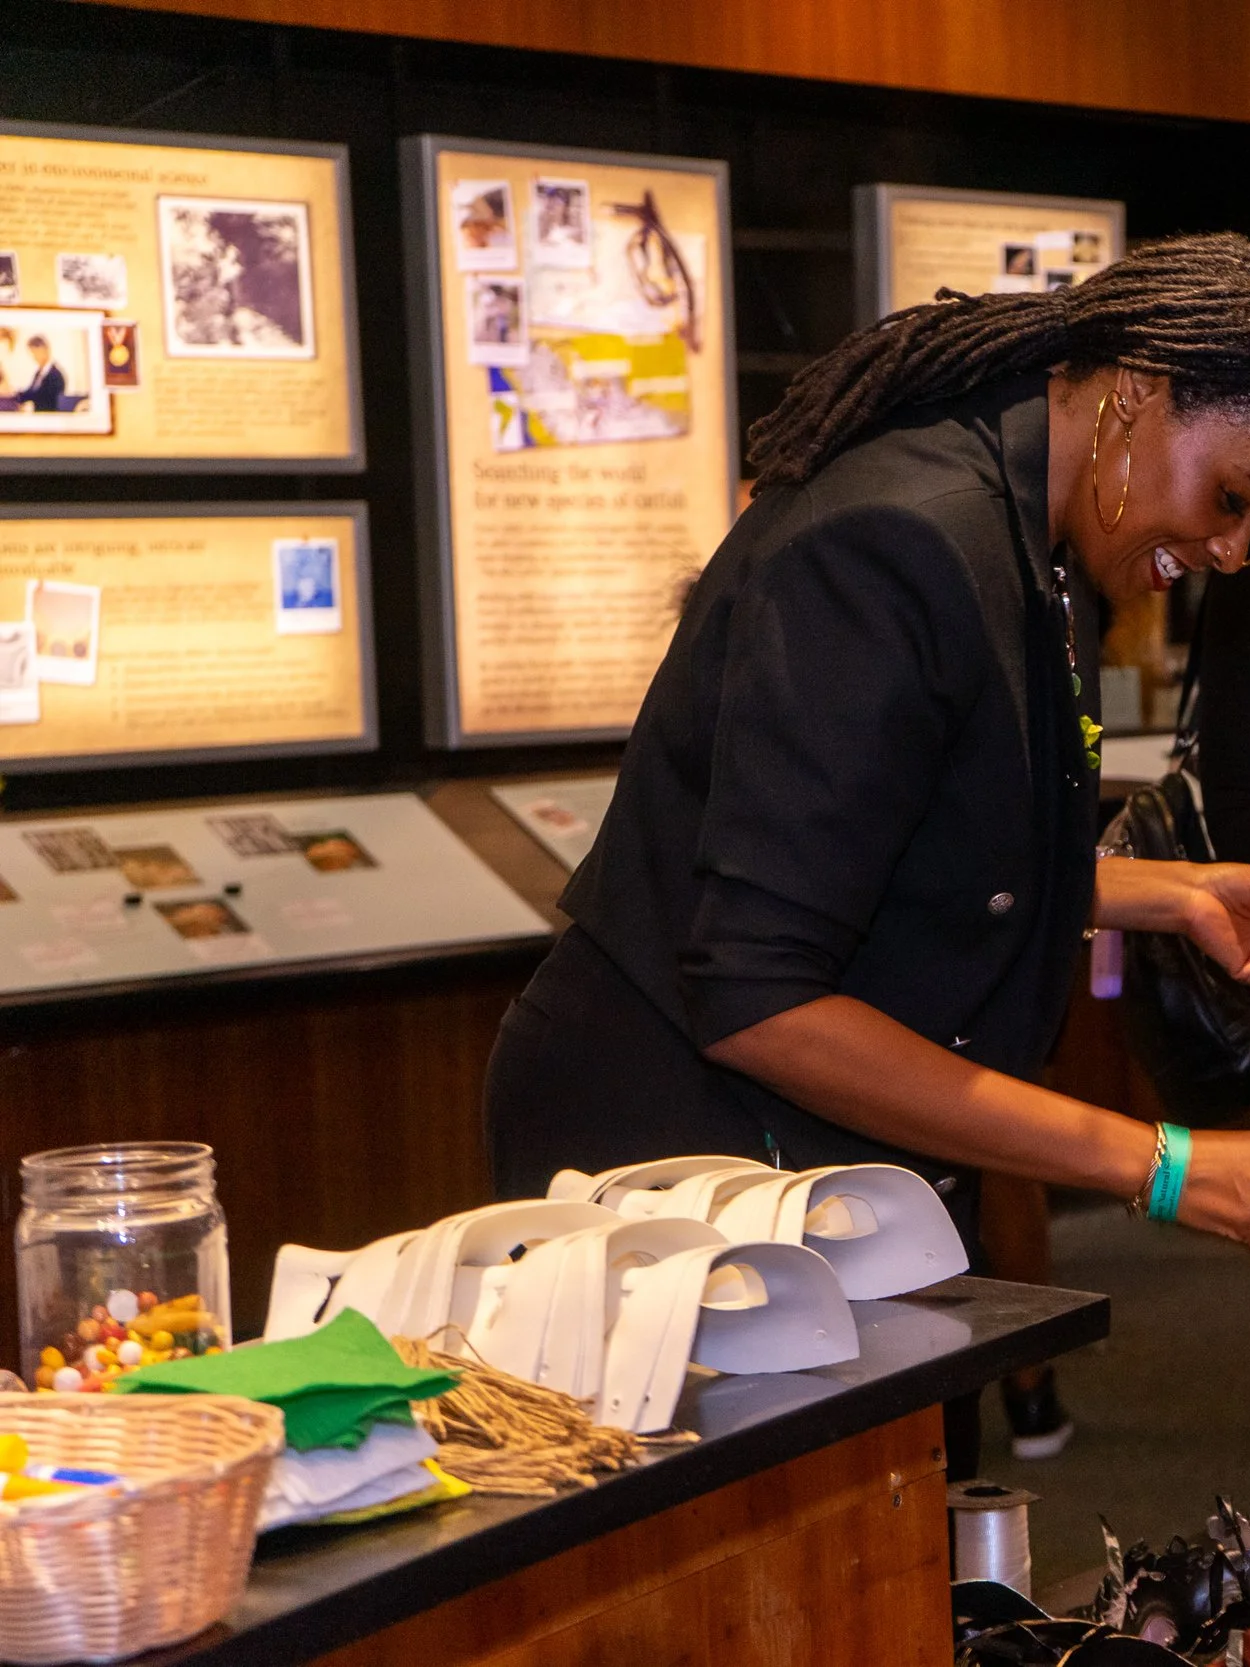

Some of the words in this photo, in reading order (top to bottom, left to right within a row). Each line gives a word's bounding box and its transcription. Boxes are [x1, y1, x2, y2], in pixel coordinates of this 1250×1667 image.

[473, 460, 560, 485] Searching
[568, 461, 591, 481] the
[600, 461, 647, 481] world
[474, 490, 498, 511] for
[505, 495, 540, 508] new
